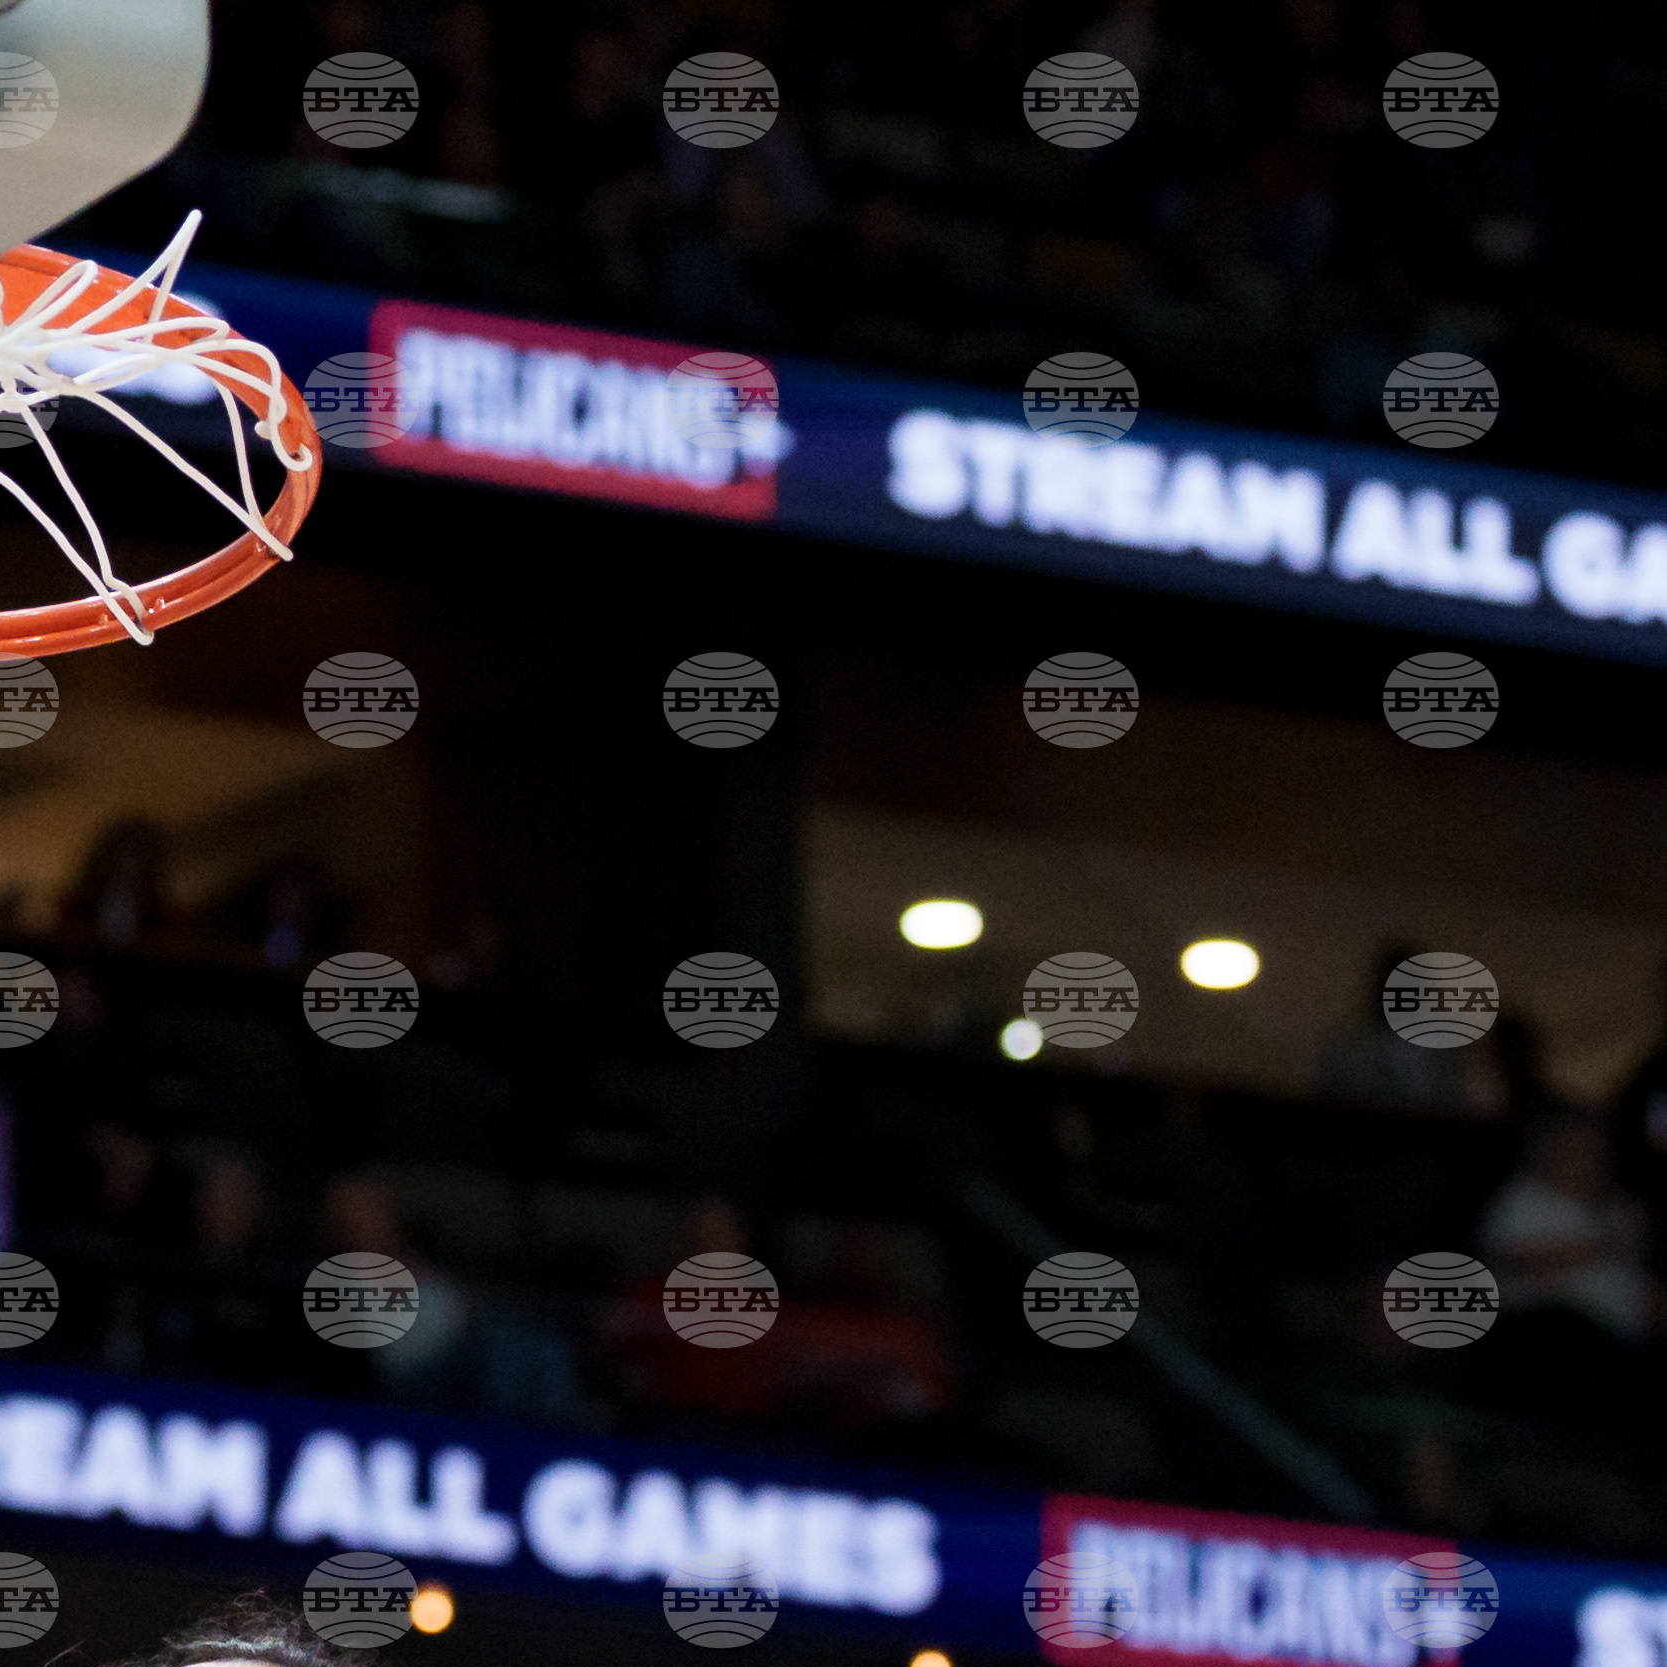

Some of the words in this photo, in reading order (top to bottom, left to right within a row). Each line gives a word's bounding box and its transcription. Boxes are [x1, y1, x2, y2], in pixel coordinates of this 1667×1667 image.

[888, 410, 1326, 572] STREAM
[1333, 480, 1536, 605] ALL
[273, 1430, 517, 1566] ALL
[522, 1458, 942, 1615] GAMES
